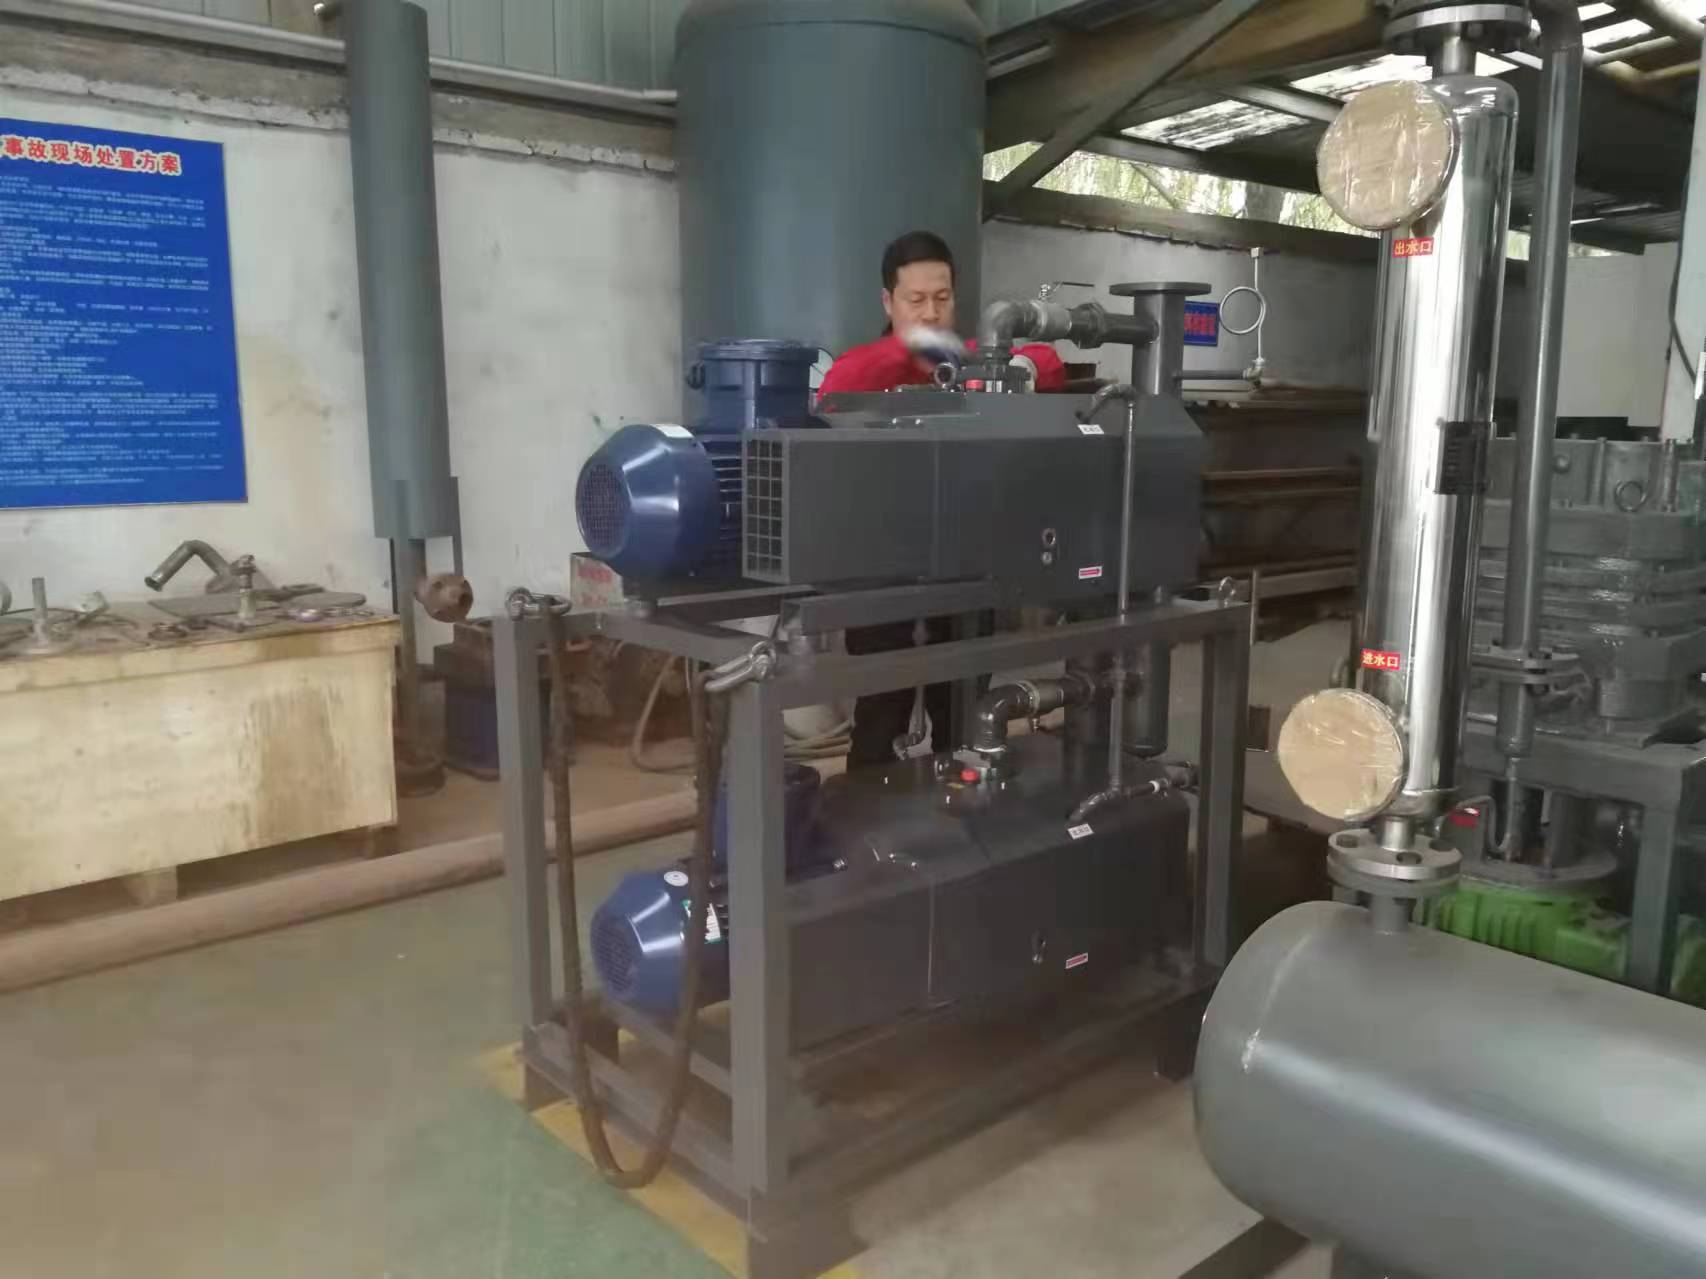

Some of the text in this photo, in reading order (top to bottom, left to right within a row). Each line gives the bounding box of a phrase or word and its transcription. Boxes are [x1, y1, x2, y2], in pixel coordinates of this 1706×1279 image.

[1394, 239, 1432, 256] 出水口
[1362, 651, 1399, 667] 进水口
